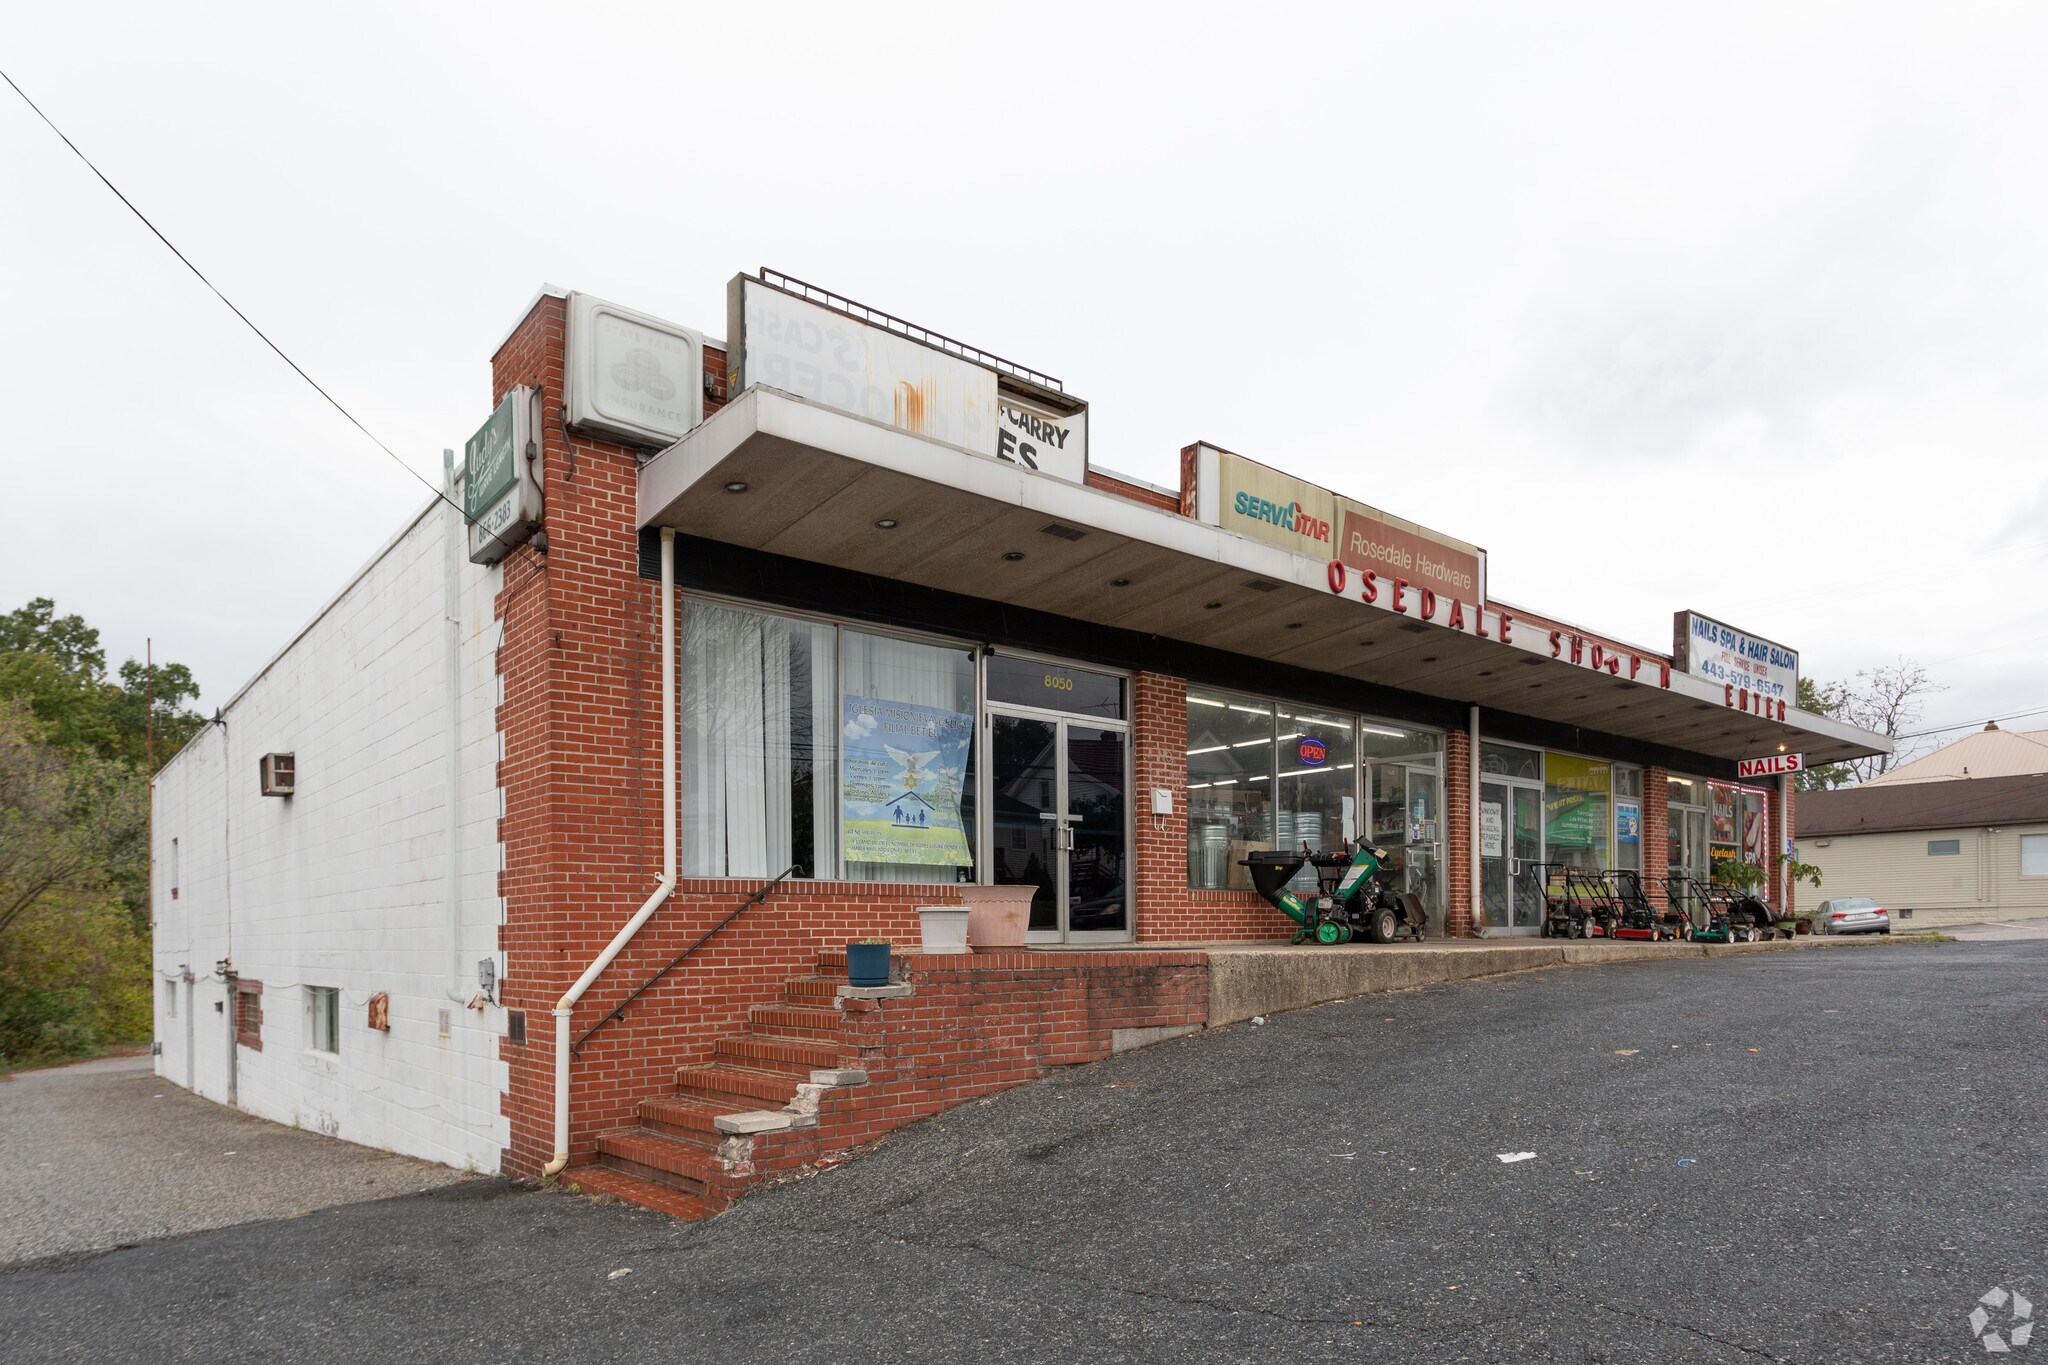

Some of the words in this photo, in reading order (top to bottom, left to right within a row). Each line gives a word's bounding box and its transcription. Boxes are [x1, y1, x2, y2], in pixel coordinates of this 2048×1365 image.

[604, 322, 641, 343] STATE
[604, 392, 682, 423] INSURANCE
[1006, 408, 1071, 450] CARRY
[1234, 491, 1330, 543] SERVISTAR
[1350, 532, 1412, 570] Rosedale
[1415, 552, 1471, 591] Hardware
[1692, 616, 1718, 644] NAILS
[1720, 629, 1736, 652] SPA
[1738, 636, 1746, 656] &
[1747, 640, 1769, 663] HAIR
[1769, 647, 1796, 671] SALON
[1721, 651, 1731, 665] FULL
[1734, 656, 1750, 672] SERVICE
[1753, 663, 1768, 676] UNISEX
[1044, 675, 1073, 692] 8050
[1701, 659, 1784, 697] 443-579-6547
[848, 703, 883, 717] IGLESIA
[884, 721, 909, 735] FILIAL
[1299, 745, 1326, 760] OPEN
[1739, 754, 1799, 778] NAILS
[1712, 803, 1733, 818] NAILS
[1710, 846, 1736, 860] Eyelash
[1744, 850, 1757, 865] SPA
